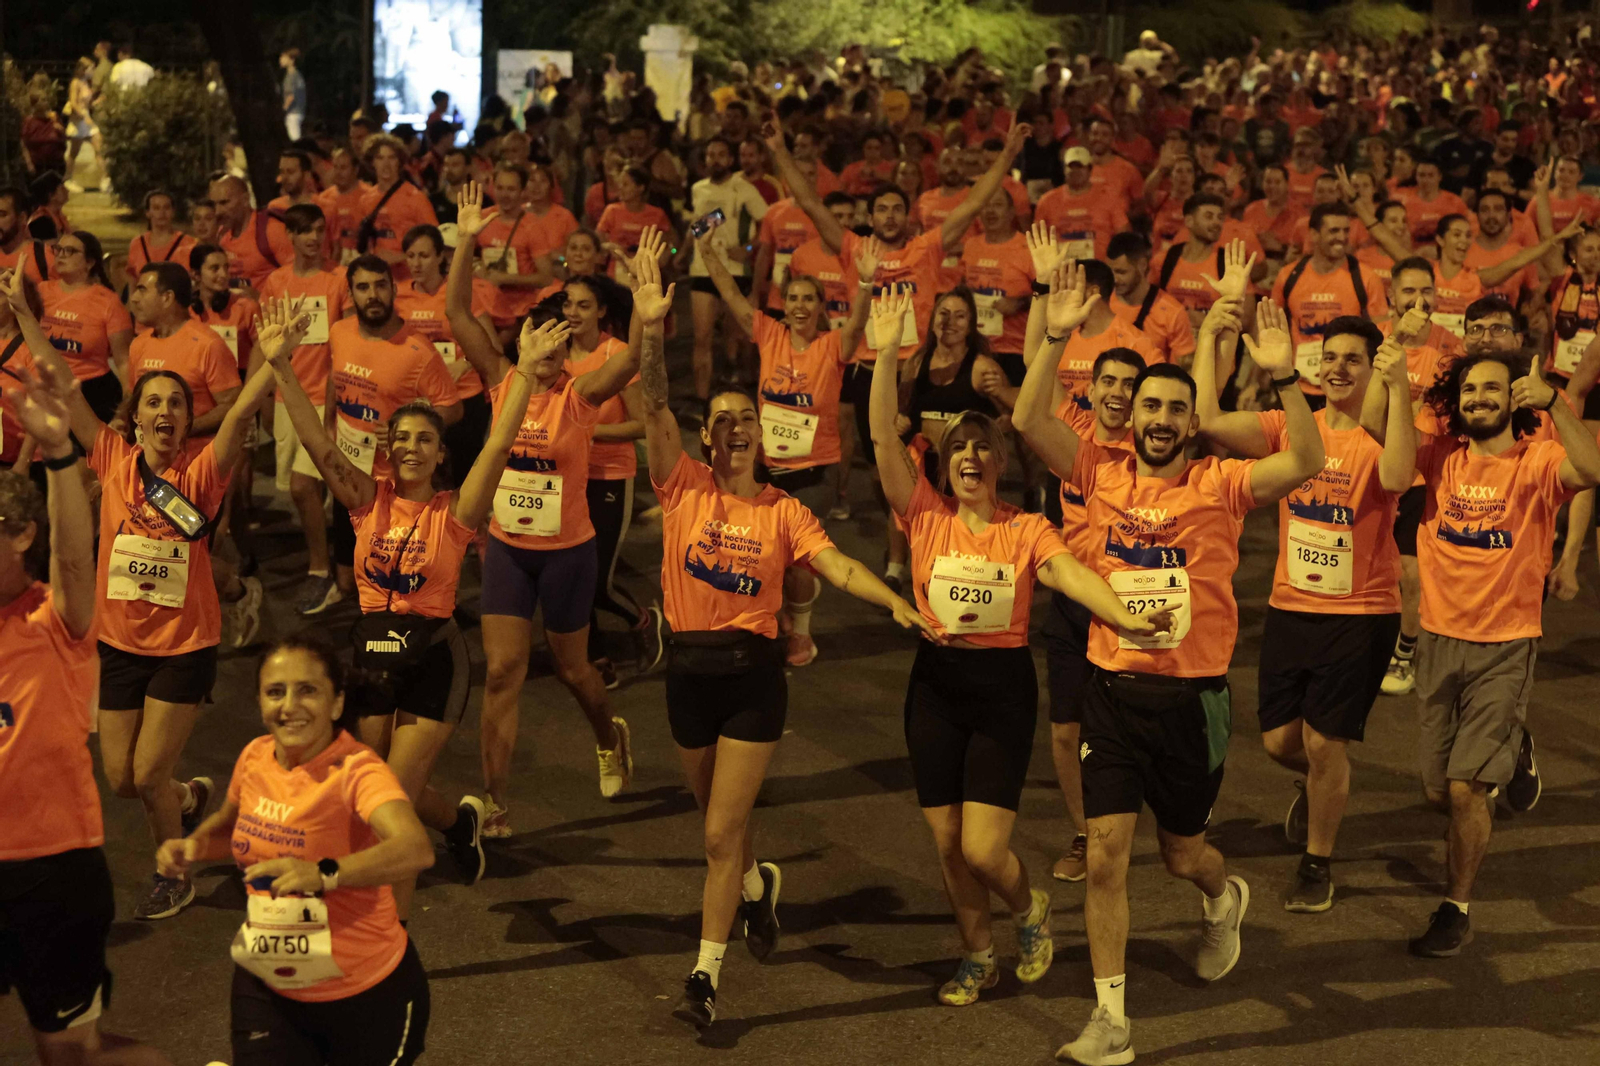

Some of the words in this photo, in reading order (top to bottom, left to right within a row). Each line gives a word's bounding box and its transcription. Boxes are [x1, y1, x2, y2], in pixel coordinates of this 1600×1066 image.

[343, 361, 373, 378] XXXV
[772, 425, 800, 441] 6235
[1459, 484, 1497, 499] XXXV
[509, 494, 543, 510] 6239
[1127, 507, 1167, 522] XXXV
[712, 519, 751, 536] XXXV
[724, 534, 762, 548] NOCTURNA
[1297, 547, 1339, 568] 18235
[129, 560, 169, 579] 6248
[950, 586, 993, 605] 6230
[365, 640, 400, 653] PUMA
[254, 796, 294, 823] XXXV
